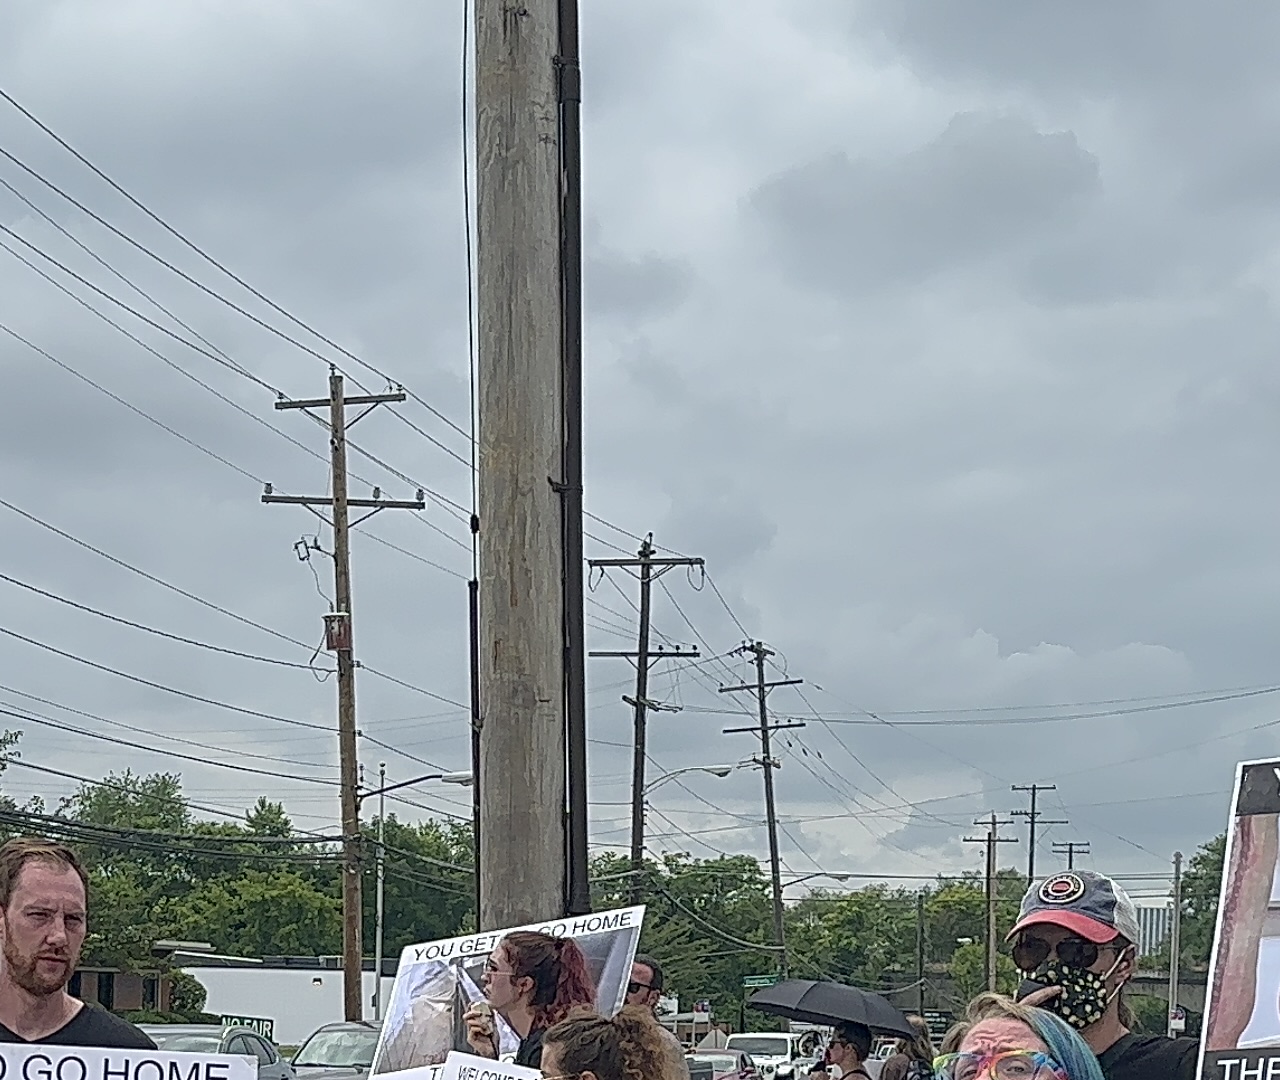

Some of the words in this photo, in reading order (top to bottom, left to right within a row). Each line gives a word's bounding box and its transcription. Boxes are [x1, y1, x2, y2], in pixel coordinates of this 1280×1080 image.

[414, 943, 453, 961] YOU
[459, 935, 501, 953] GET
[572, 911, 633, 935] HOME
